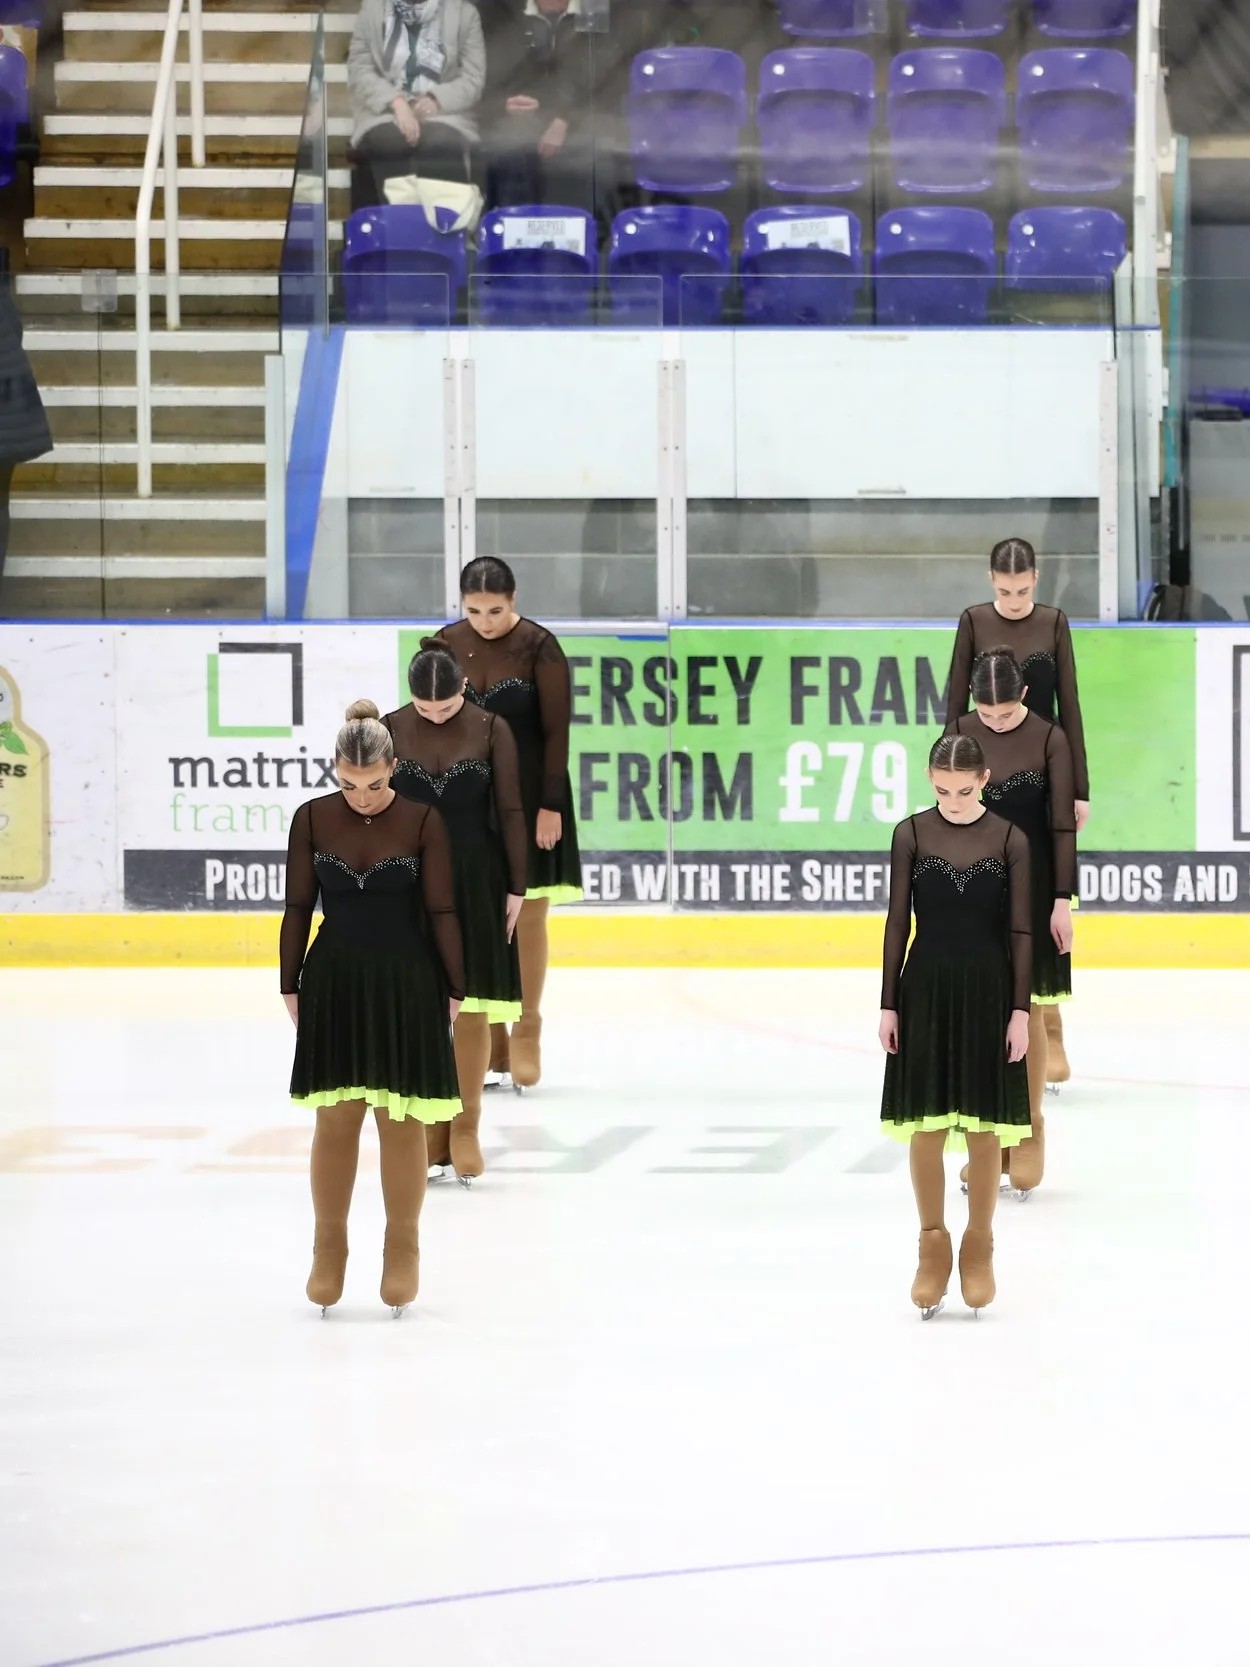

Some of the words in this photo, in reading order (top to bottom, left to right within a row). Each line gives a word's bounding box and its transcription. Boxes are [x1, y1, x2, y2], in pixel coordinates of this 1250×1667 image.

[569, 656, 763, 727] ERSEY
[790, 656, 951, 727] FRAM
[168, 746, 341, 788] matrix
[579, 752, 753, 822] FROM
[170, 793, 289, 833] fram
[205, 858, 286, 901] PROU
[632, 864, 720, 901] WITH
[731, 864, 792, 901] THE
[802, 859, 891, 902] SHEF
[1079, 864, 1163, 902] DOGS
[1173, 865, 1238, 902] AND
